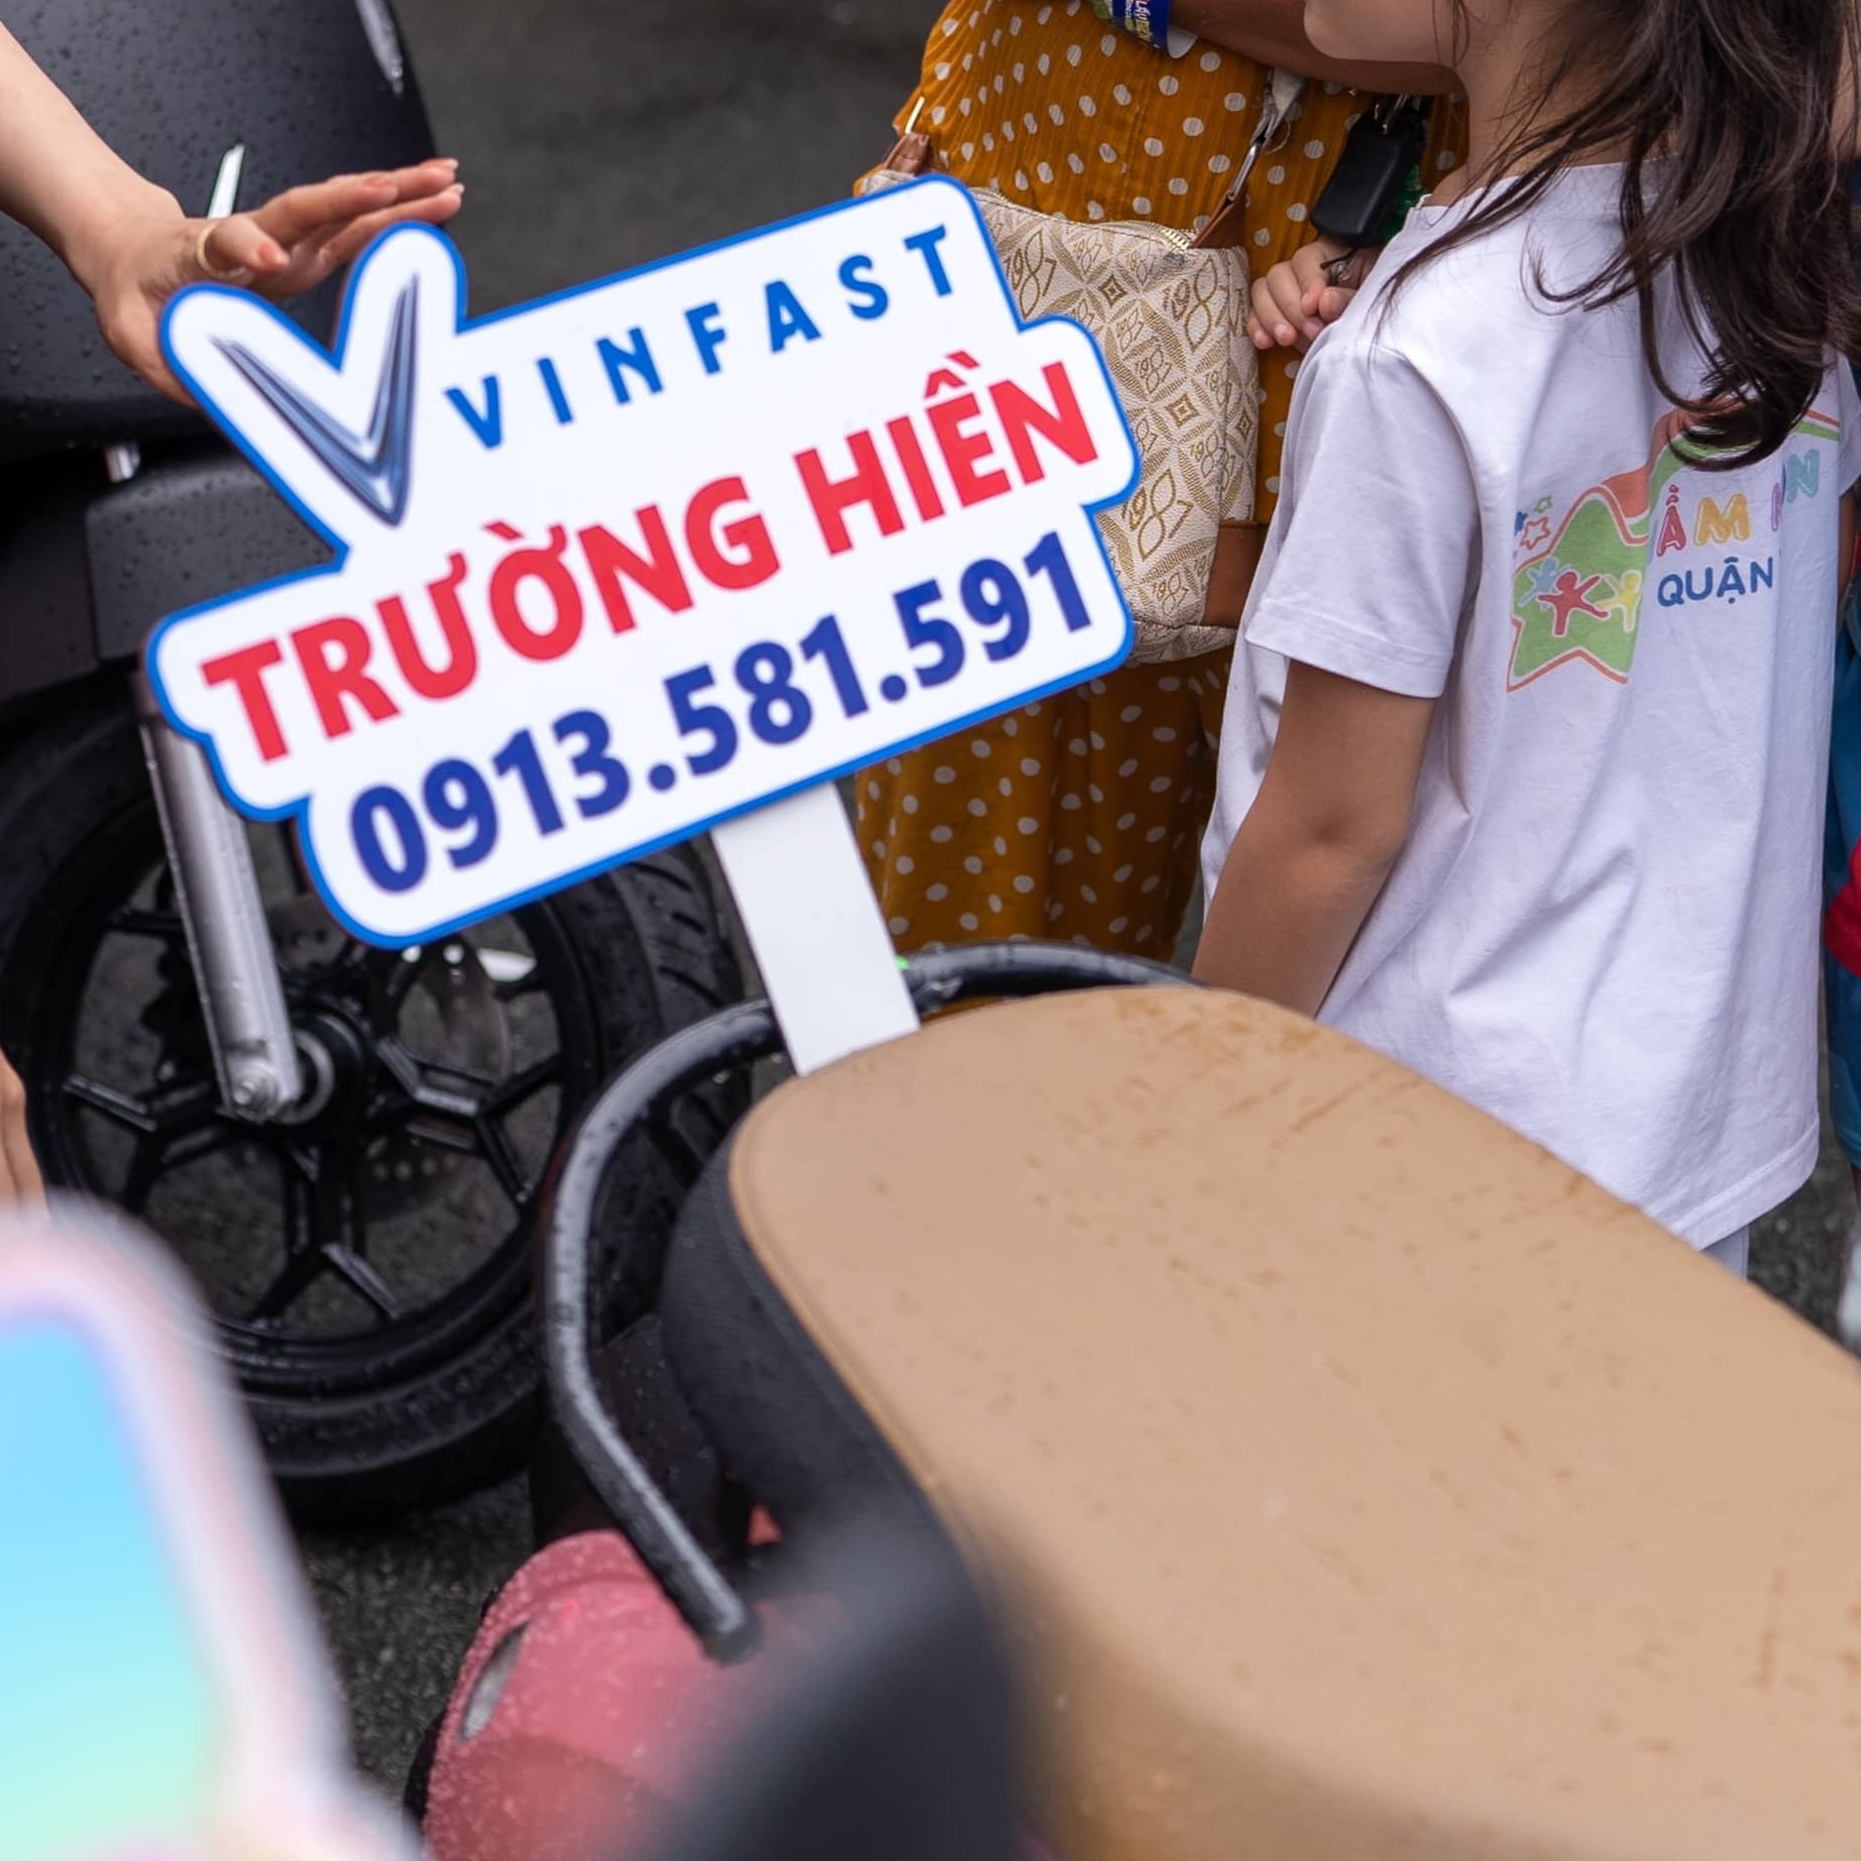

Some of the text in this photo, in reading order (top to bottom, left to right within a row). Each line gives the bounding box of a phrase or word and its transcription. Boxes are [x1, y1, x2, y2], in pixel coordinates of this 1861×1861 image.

[445, 225, 953, 448] VINFAST
[201, 351, 1099, 765] TRƯỜNG HIỀN
[1657, 556, 1773, 607] QUẬN
[348, 532, 1092, 894] 0913.581.591
